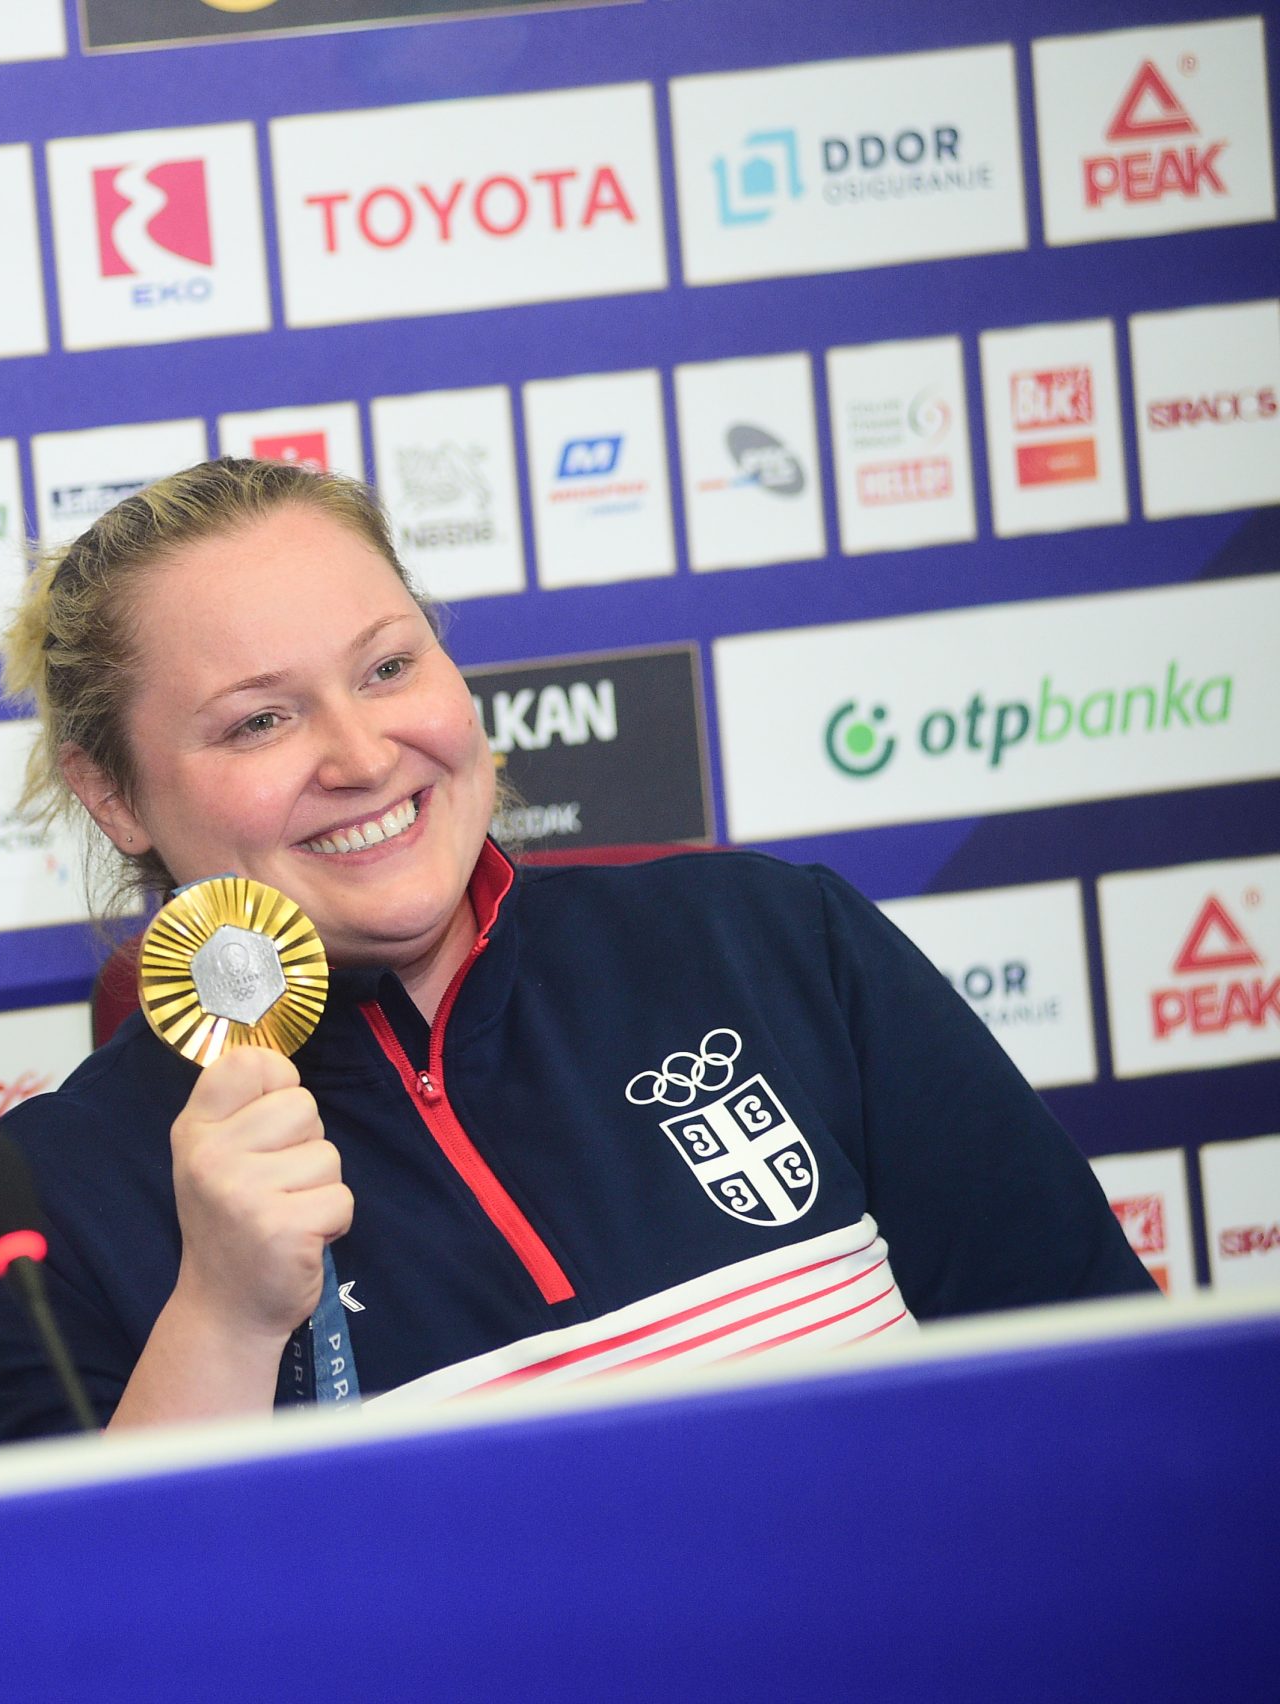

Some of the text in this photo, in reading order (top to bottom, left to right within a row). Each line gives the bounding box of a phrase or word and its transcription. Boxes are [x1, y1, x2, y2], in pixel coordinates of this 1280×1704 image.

[823, 127, 960, 172] DDOR
[1082, 141, 1228, 209] PEAK
[304, 164, 637, 255] TOYOTA
[131, 277, 214, 309] EKO
[919, 661, 1234, 768] otpbanka
